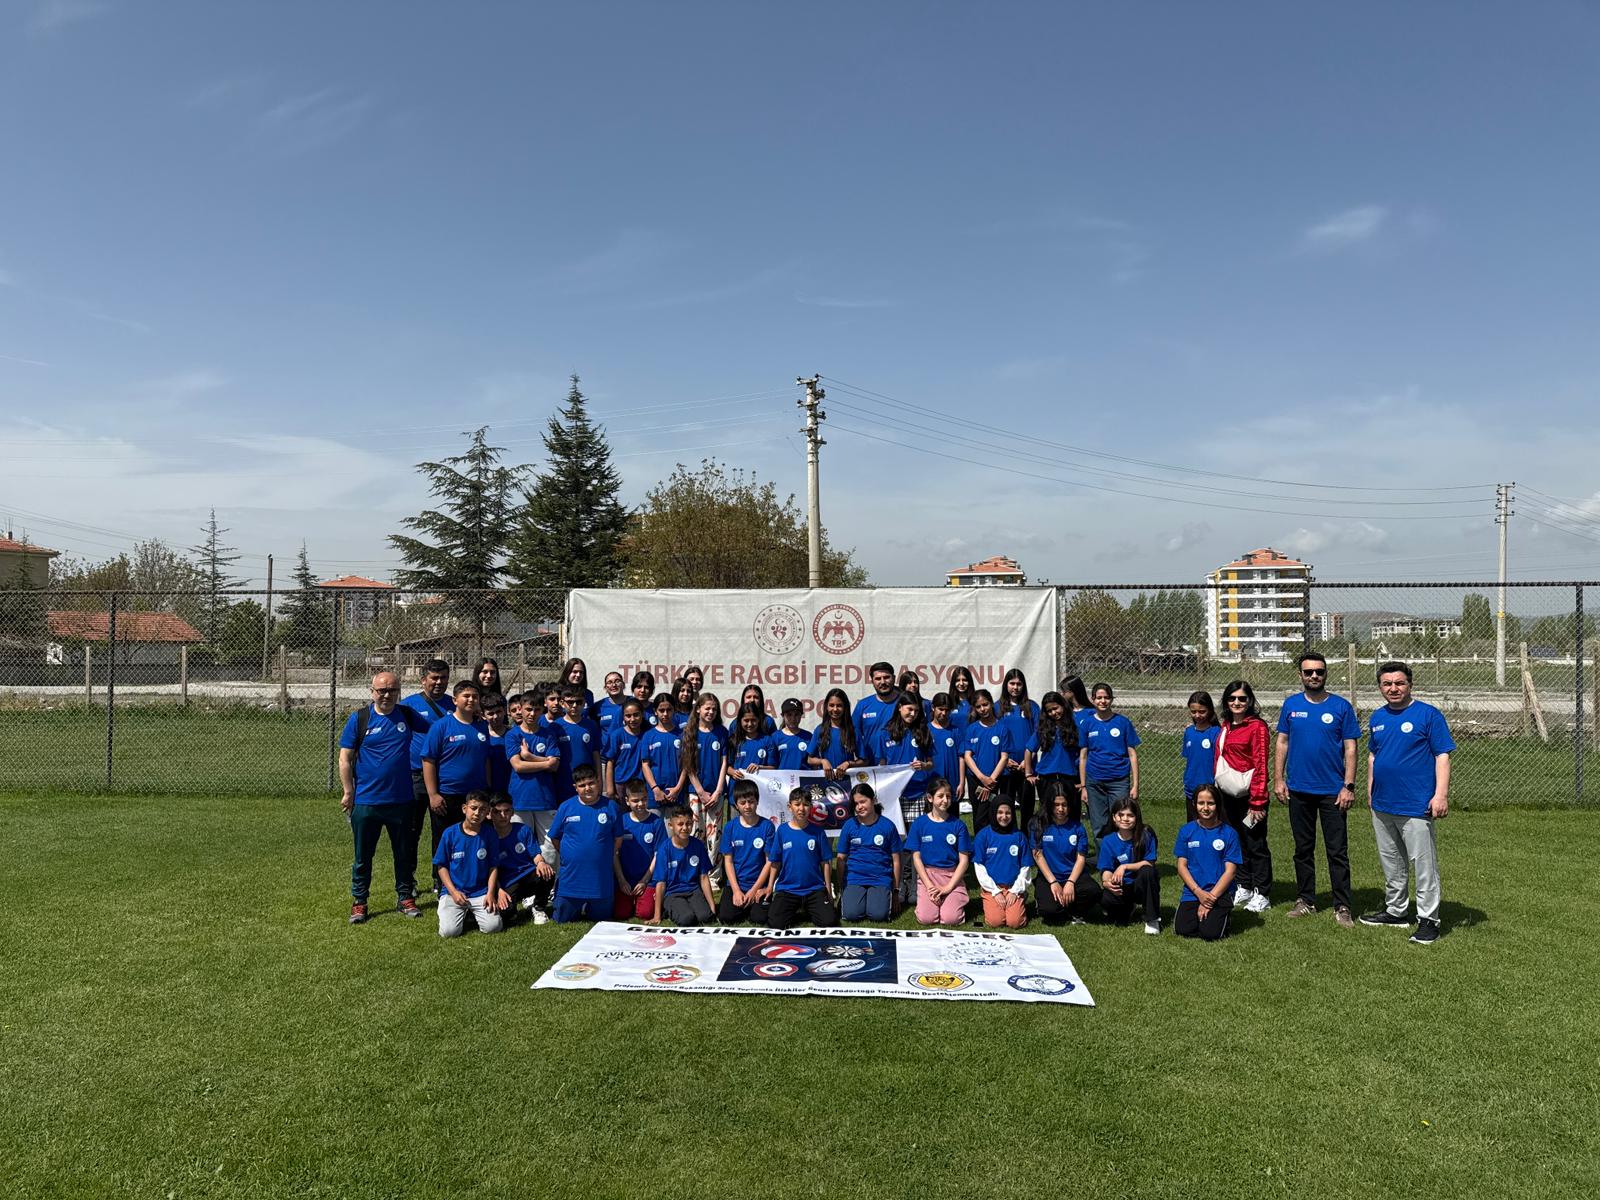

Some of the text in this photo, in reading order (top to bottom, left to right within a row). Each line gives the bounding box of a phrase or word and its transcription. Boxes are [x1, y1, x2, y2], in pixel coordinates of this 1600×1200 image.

[618, 660, 1005, 686] TÜRKE RAGBİ FEDEASYNU
[626, 926, 739, 935] GENÇLİK
[809, 929, 954, 938] HAREKETE
